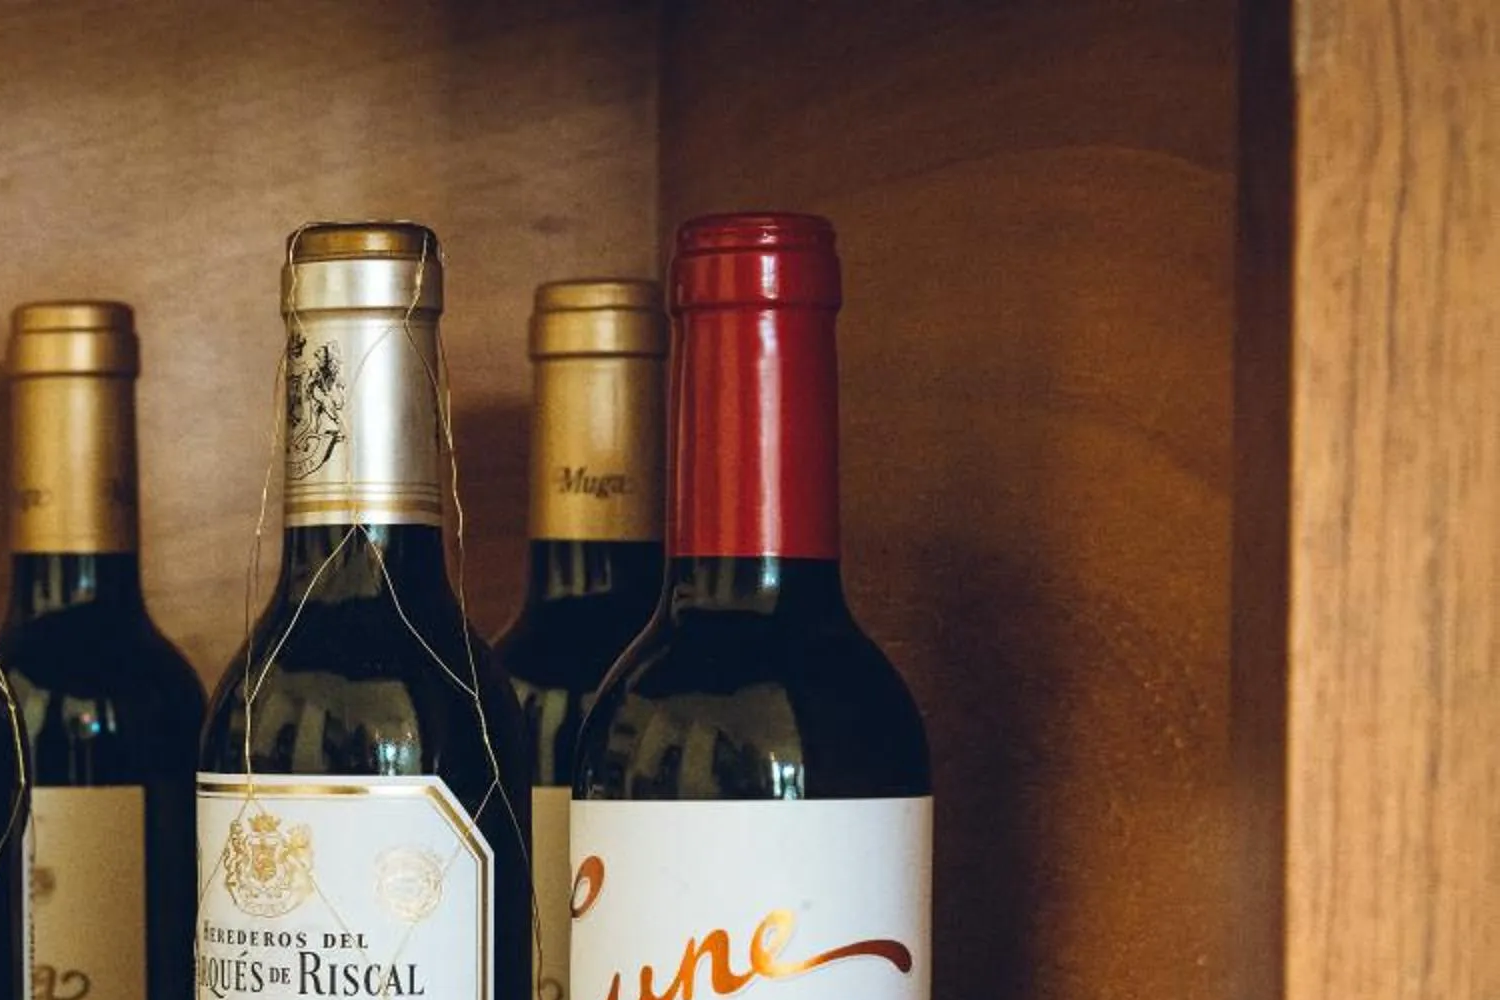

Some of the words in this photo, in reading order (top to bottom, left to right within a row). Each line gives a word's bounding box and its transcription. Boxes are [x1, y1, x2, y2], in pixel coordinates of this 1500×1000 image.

[558, 466, 632, 498] Muga
[323, 932, 369, 950] DEL
[269, 966, 291, 985] DE
[297, 951, 426, 997] RISCAL
